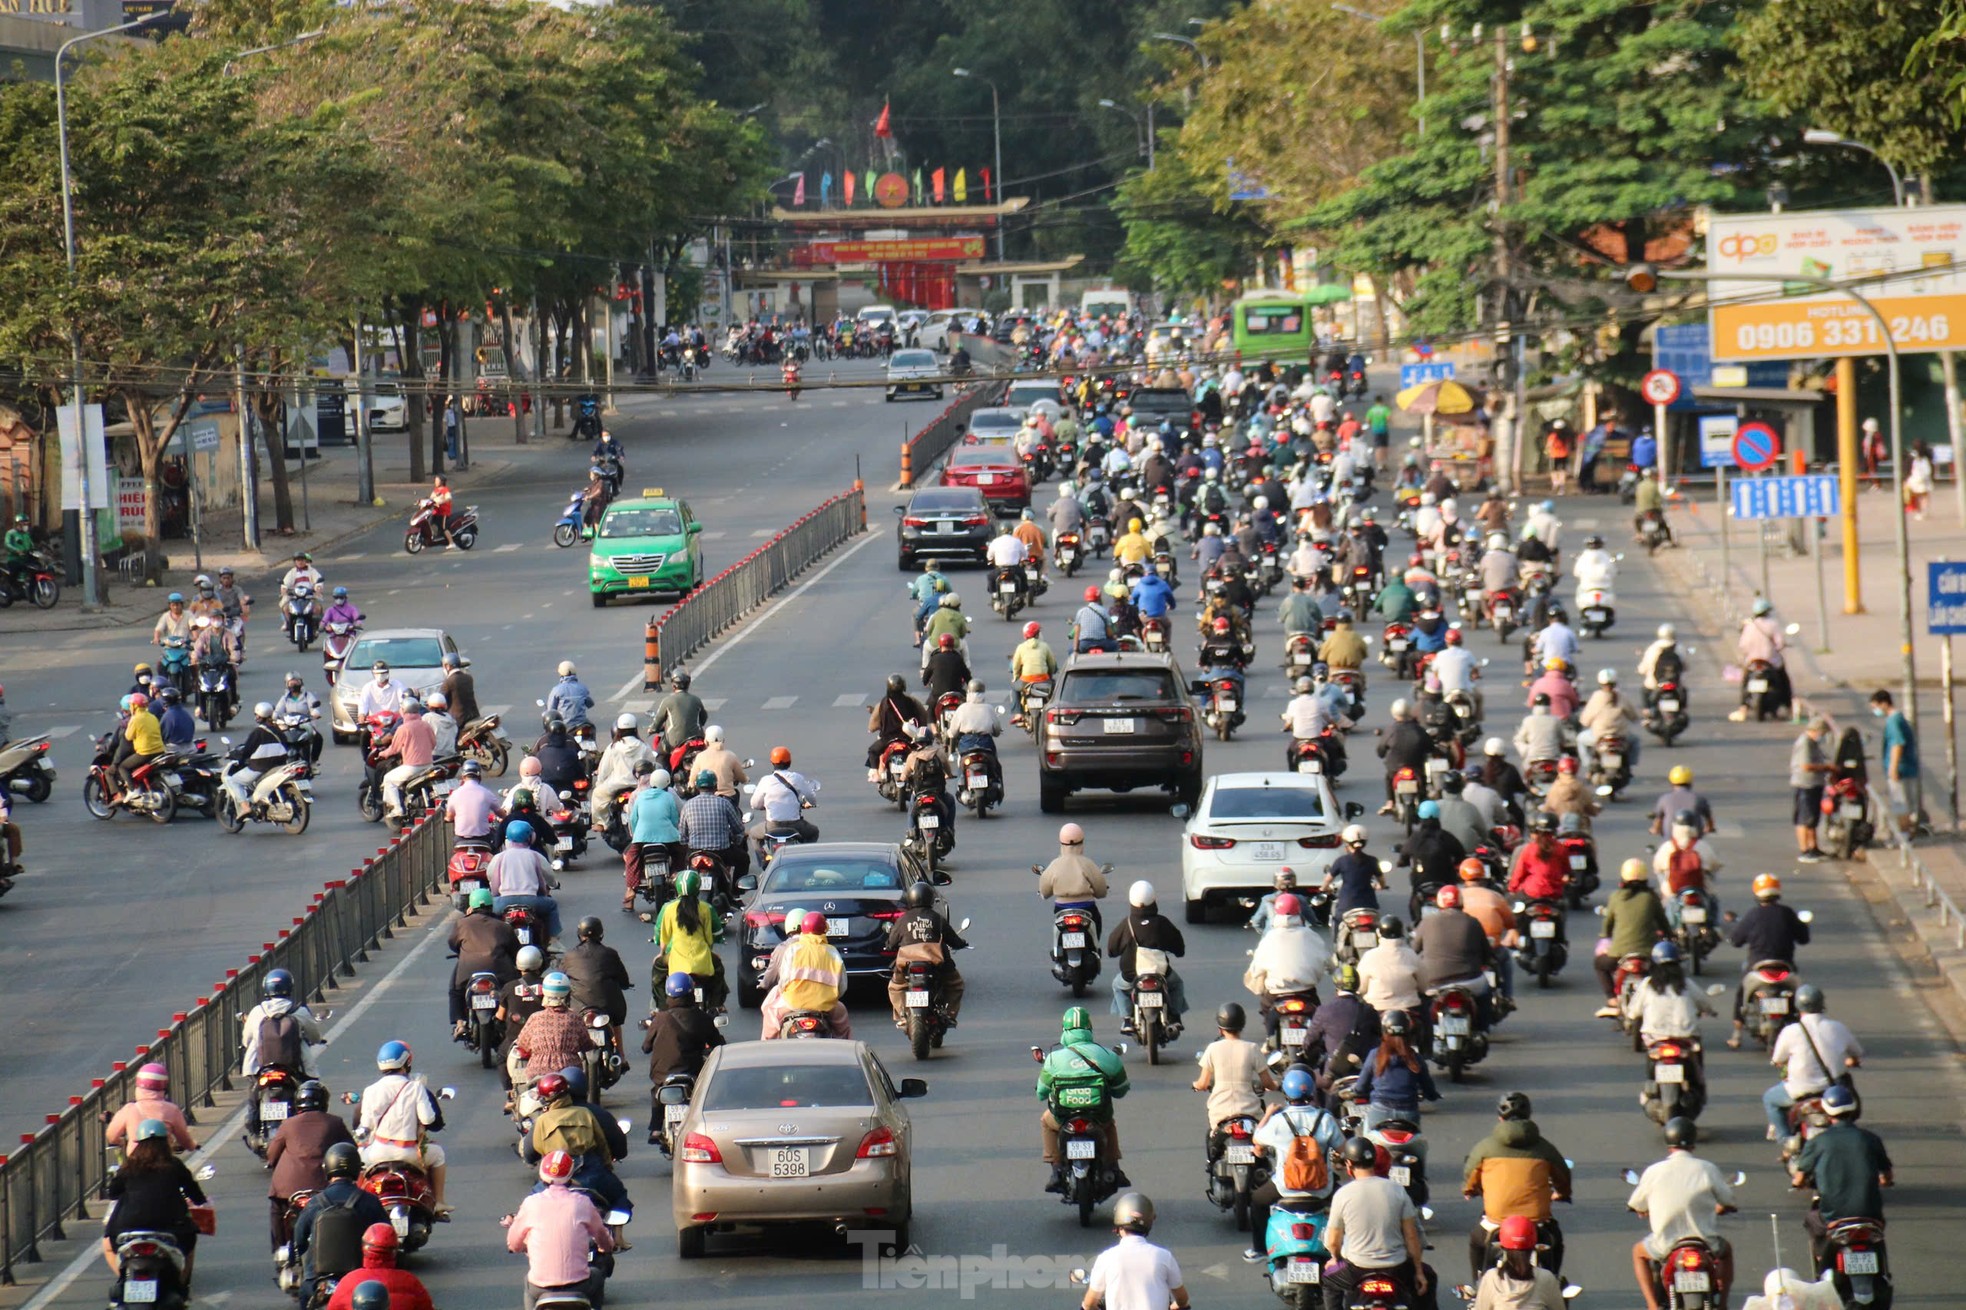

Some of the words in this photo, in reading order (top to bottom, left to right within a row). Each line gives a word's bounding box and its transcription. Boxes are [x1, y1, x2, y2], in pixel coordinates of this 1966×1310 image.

[1738, 323, 1814, 350] 0906
[1822, 320, 1879, 346] 331
[1891, 315, 1949, 344] 246
[1066, 1095, 1092, 1105] Food
[777, 1150, 801, 1163] 60S
[774, 1162, 805, 1176] 5398
